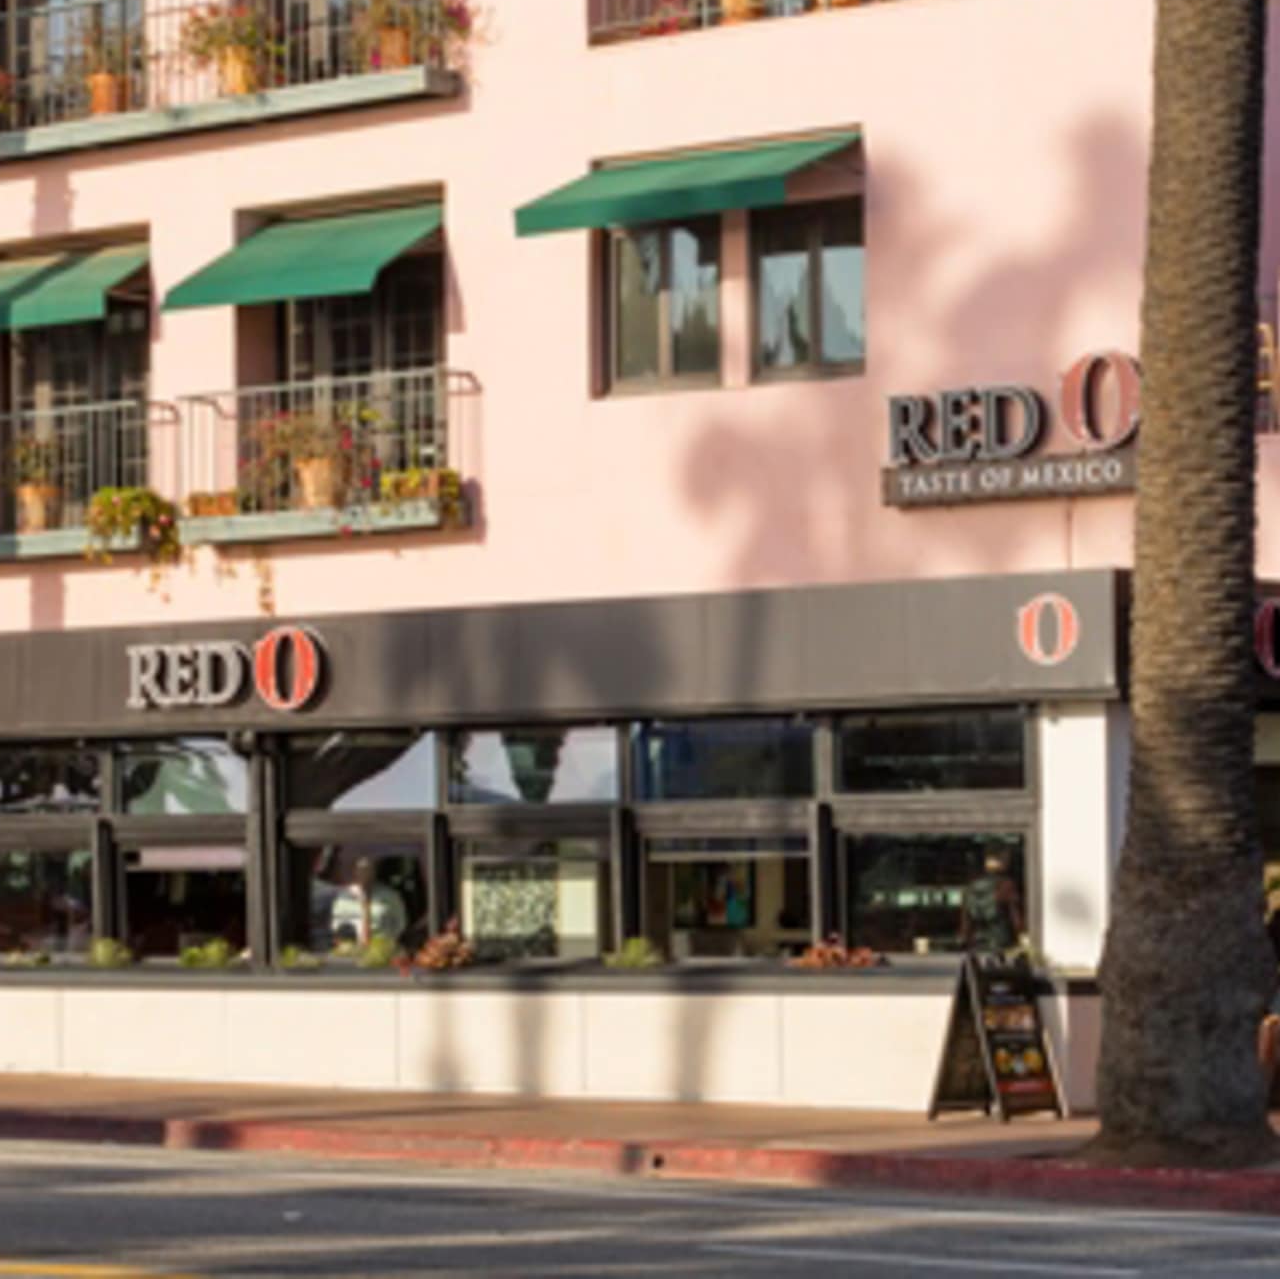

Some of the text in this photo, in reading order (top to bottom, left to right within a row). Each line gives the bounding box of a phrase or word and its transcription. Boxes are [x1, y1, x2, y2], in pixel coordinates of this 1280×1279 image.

[886, 351, 1141, 464] RED O
[897, 458, 1123, 497] TASTE OF MEXICO
[125, 624, 322, 712] RED O
